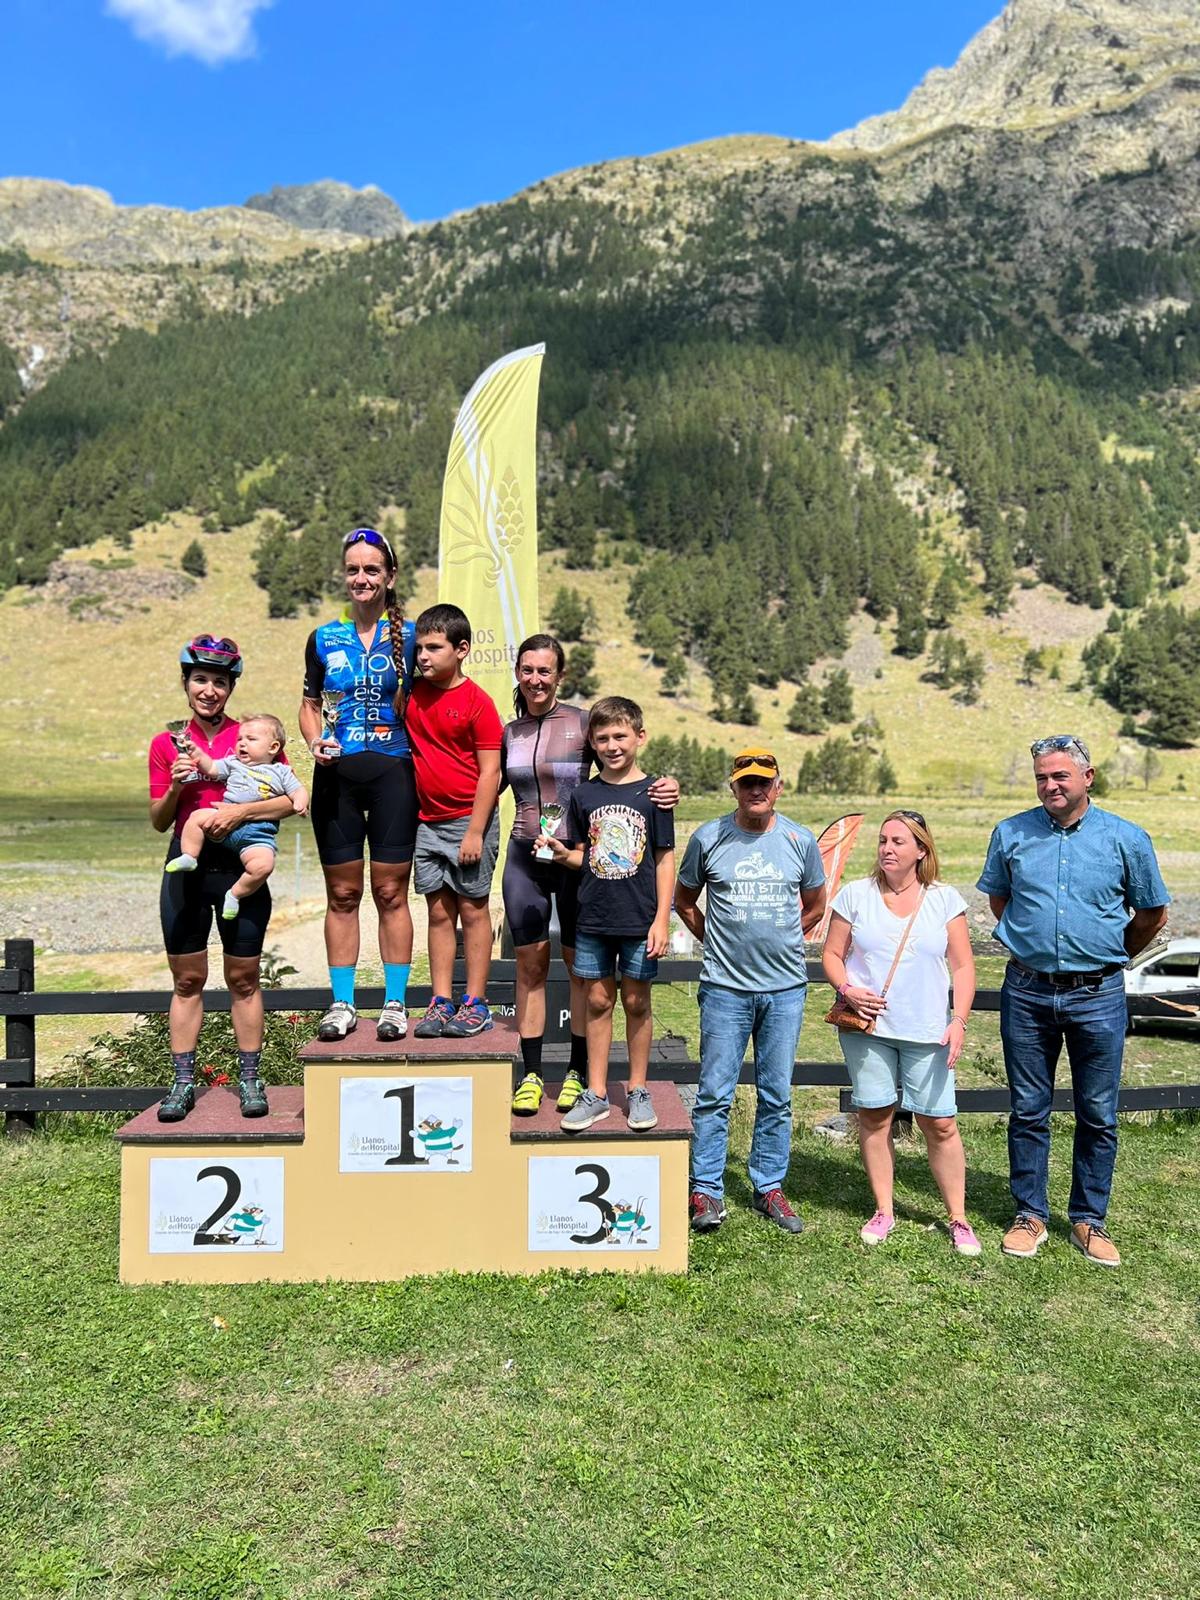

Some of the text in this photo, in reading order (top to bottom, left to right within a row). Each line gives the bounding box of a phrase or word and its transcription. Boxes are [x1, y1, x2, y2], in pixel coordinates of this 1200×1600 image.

[353, 707, 381, 721] ca
[346, 726, 393, 742] Torres
[729, 881, 787, 895] XXIX BTT
[384, 1084, 430, 1165] 1
[362, 1136, 385, 1144] Llanos
[193, 1165, 242, 1246] 2
[569, 1163, 617, 1245] 3
[169, 1215, 193, 1223] Llanos
[550, 1215, 574, 1223] Llanos
